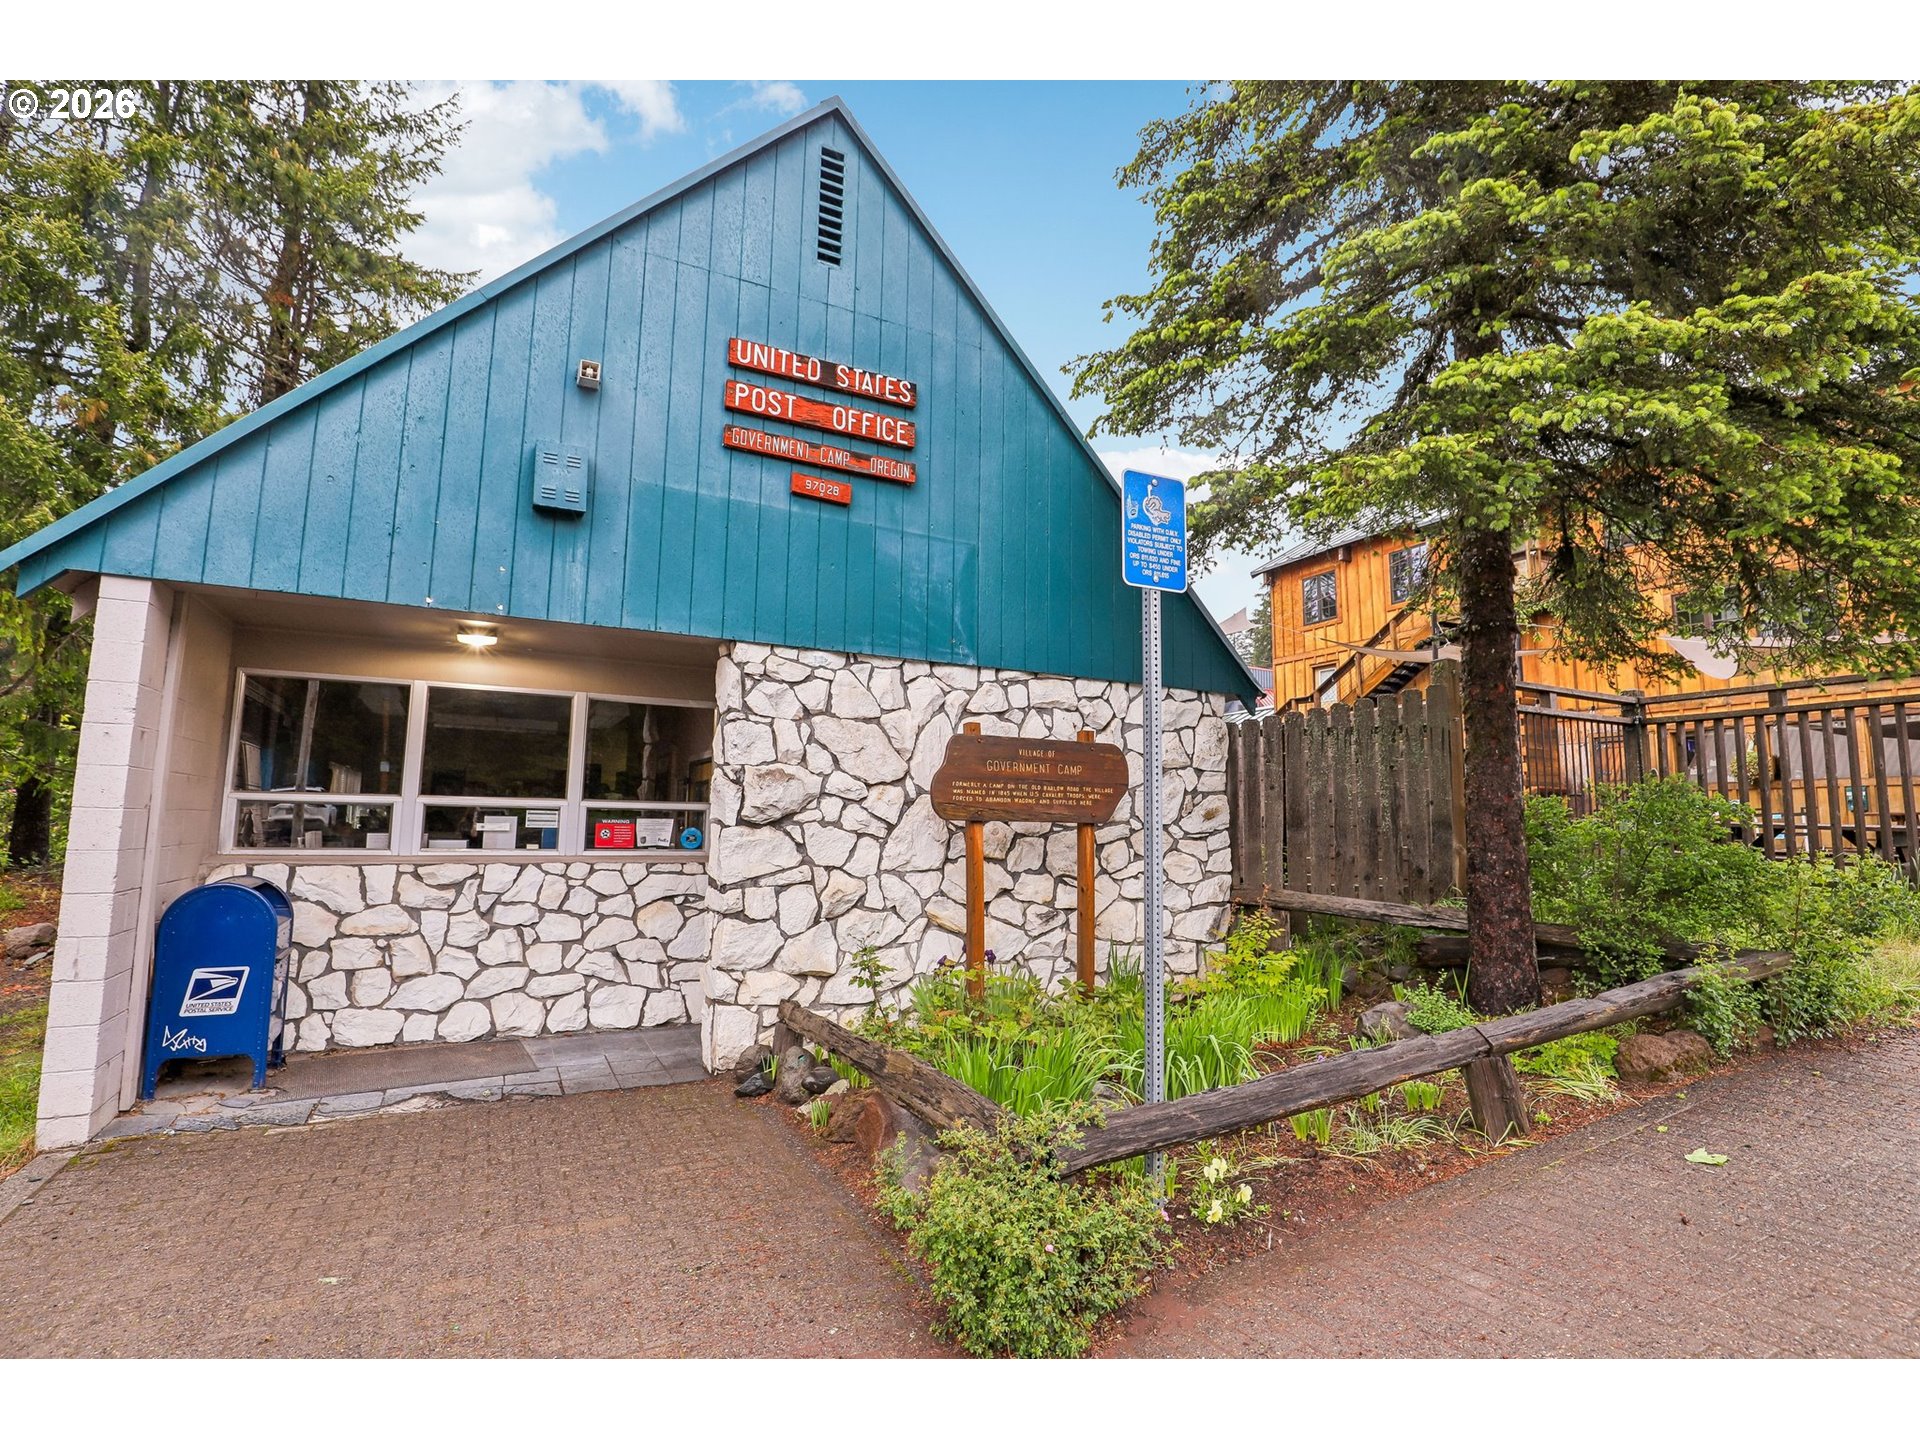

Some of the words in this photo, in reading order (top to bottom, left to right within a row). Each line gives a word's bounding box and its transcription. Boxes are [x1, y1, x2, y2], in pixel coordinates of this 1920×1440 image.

[736, 339, 821, 381] UNITED
[837, 365, 912, 403] STATES
[734, 383, 797, 418] POST
[832, 406, 909, 445] OFFICE
[731, 427, 810, 459] GOVERNMENT
[819, 447, 850, 467] CAMP
[870, 457, 910, 479] OREGON
[805, 479, 840, 496] 97028
[1130, 522, 1151, 532] PARKING
[1152, 526, 1165, 534] WITH
[1127, 529, 1151, 539] DISABLED
[1151, 533, 1169, 542] PERMIT
[1170, 537, 1182, 545] ONLY
[1127, 536, 1154, 547] VIOLATORS
[1154, 541, 1176, 551] SUBJECT
[1137, 545, 1157, 555] TOWING
[1157, 549, 1174, 558] UNDER
[1132, 559, 1140, 567] UP
[1140, 560, 1148, 568] TO
[1161, 564, 1178, 574] UNDER
[1159, 556, 1170, 564] AND
[1170, 559, 1181, 567] FINE
[1018, 748, 1044, 758] VILLAGE
[1047, 750, 1056, 758] OF
[986, 760, 1050, 774] GOVERNMENT
[1057, 763, 1083, 776] CAMP
